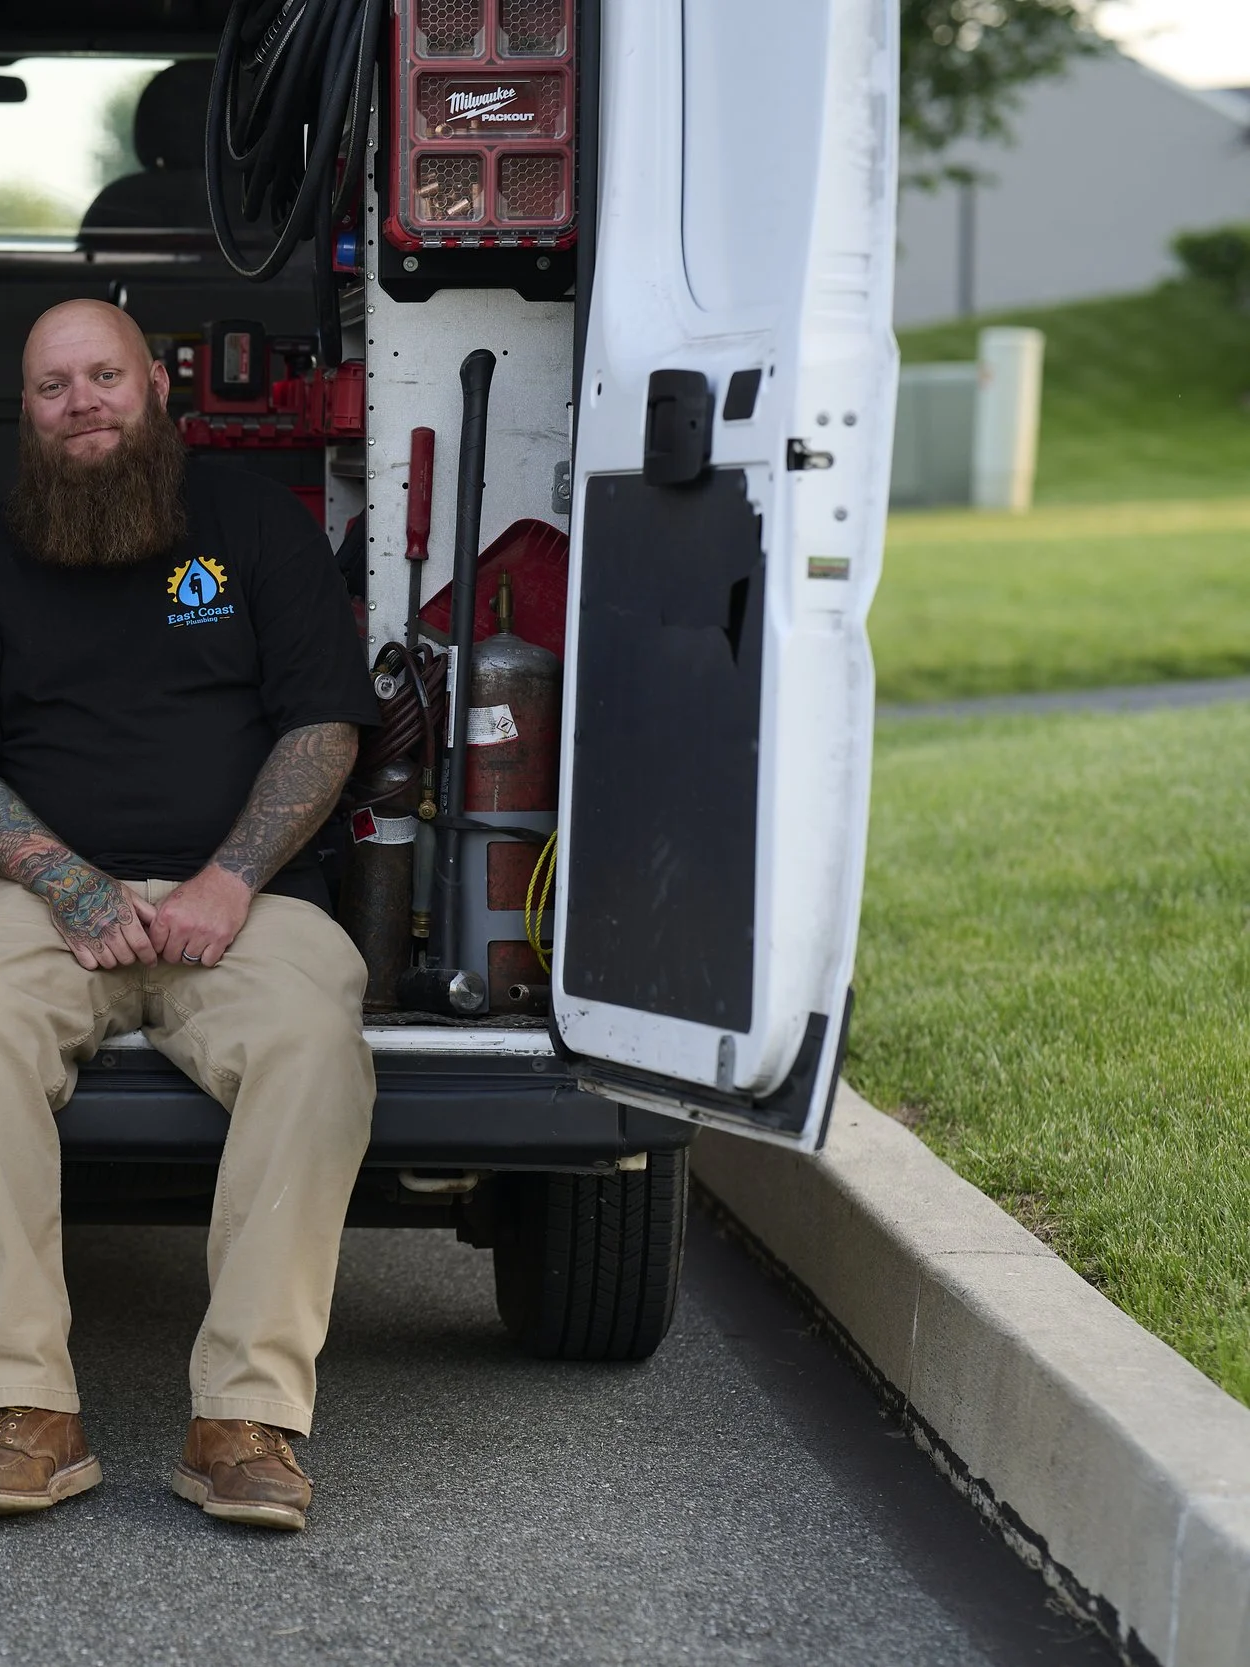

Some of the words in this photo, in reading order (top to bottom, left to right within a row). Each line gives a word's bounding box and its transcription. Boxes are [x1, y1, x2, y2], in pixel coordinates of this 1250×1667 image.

[445, 86, 517, 115] Milwaukee
[481, 113, 535, 122] PACKOUT
[167, 611, 195, 625] East
[198, 604, 235, 617] Coast
[186, 617, 218, 626] Plumbing
